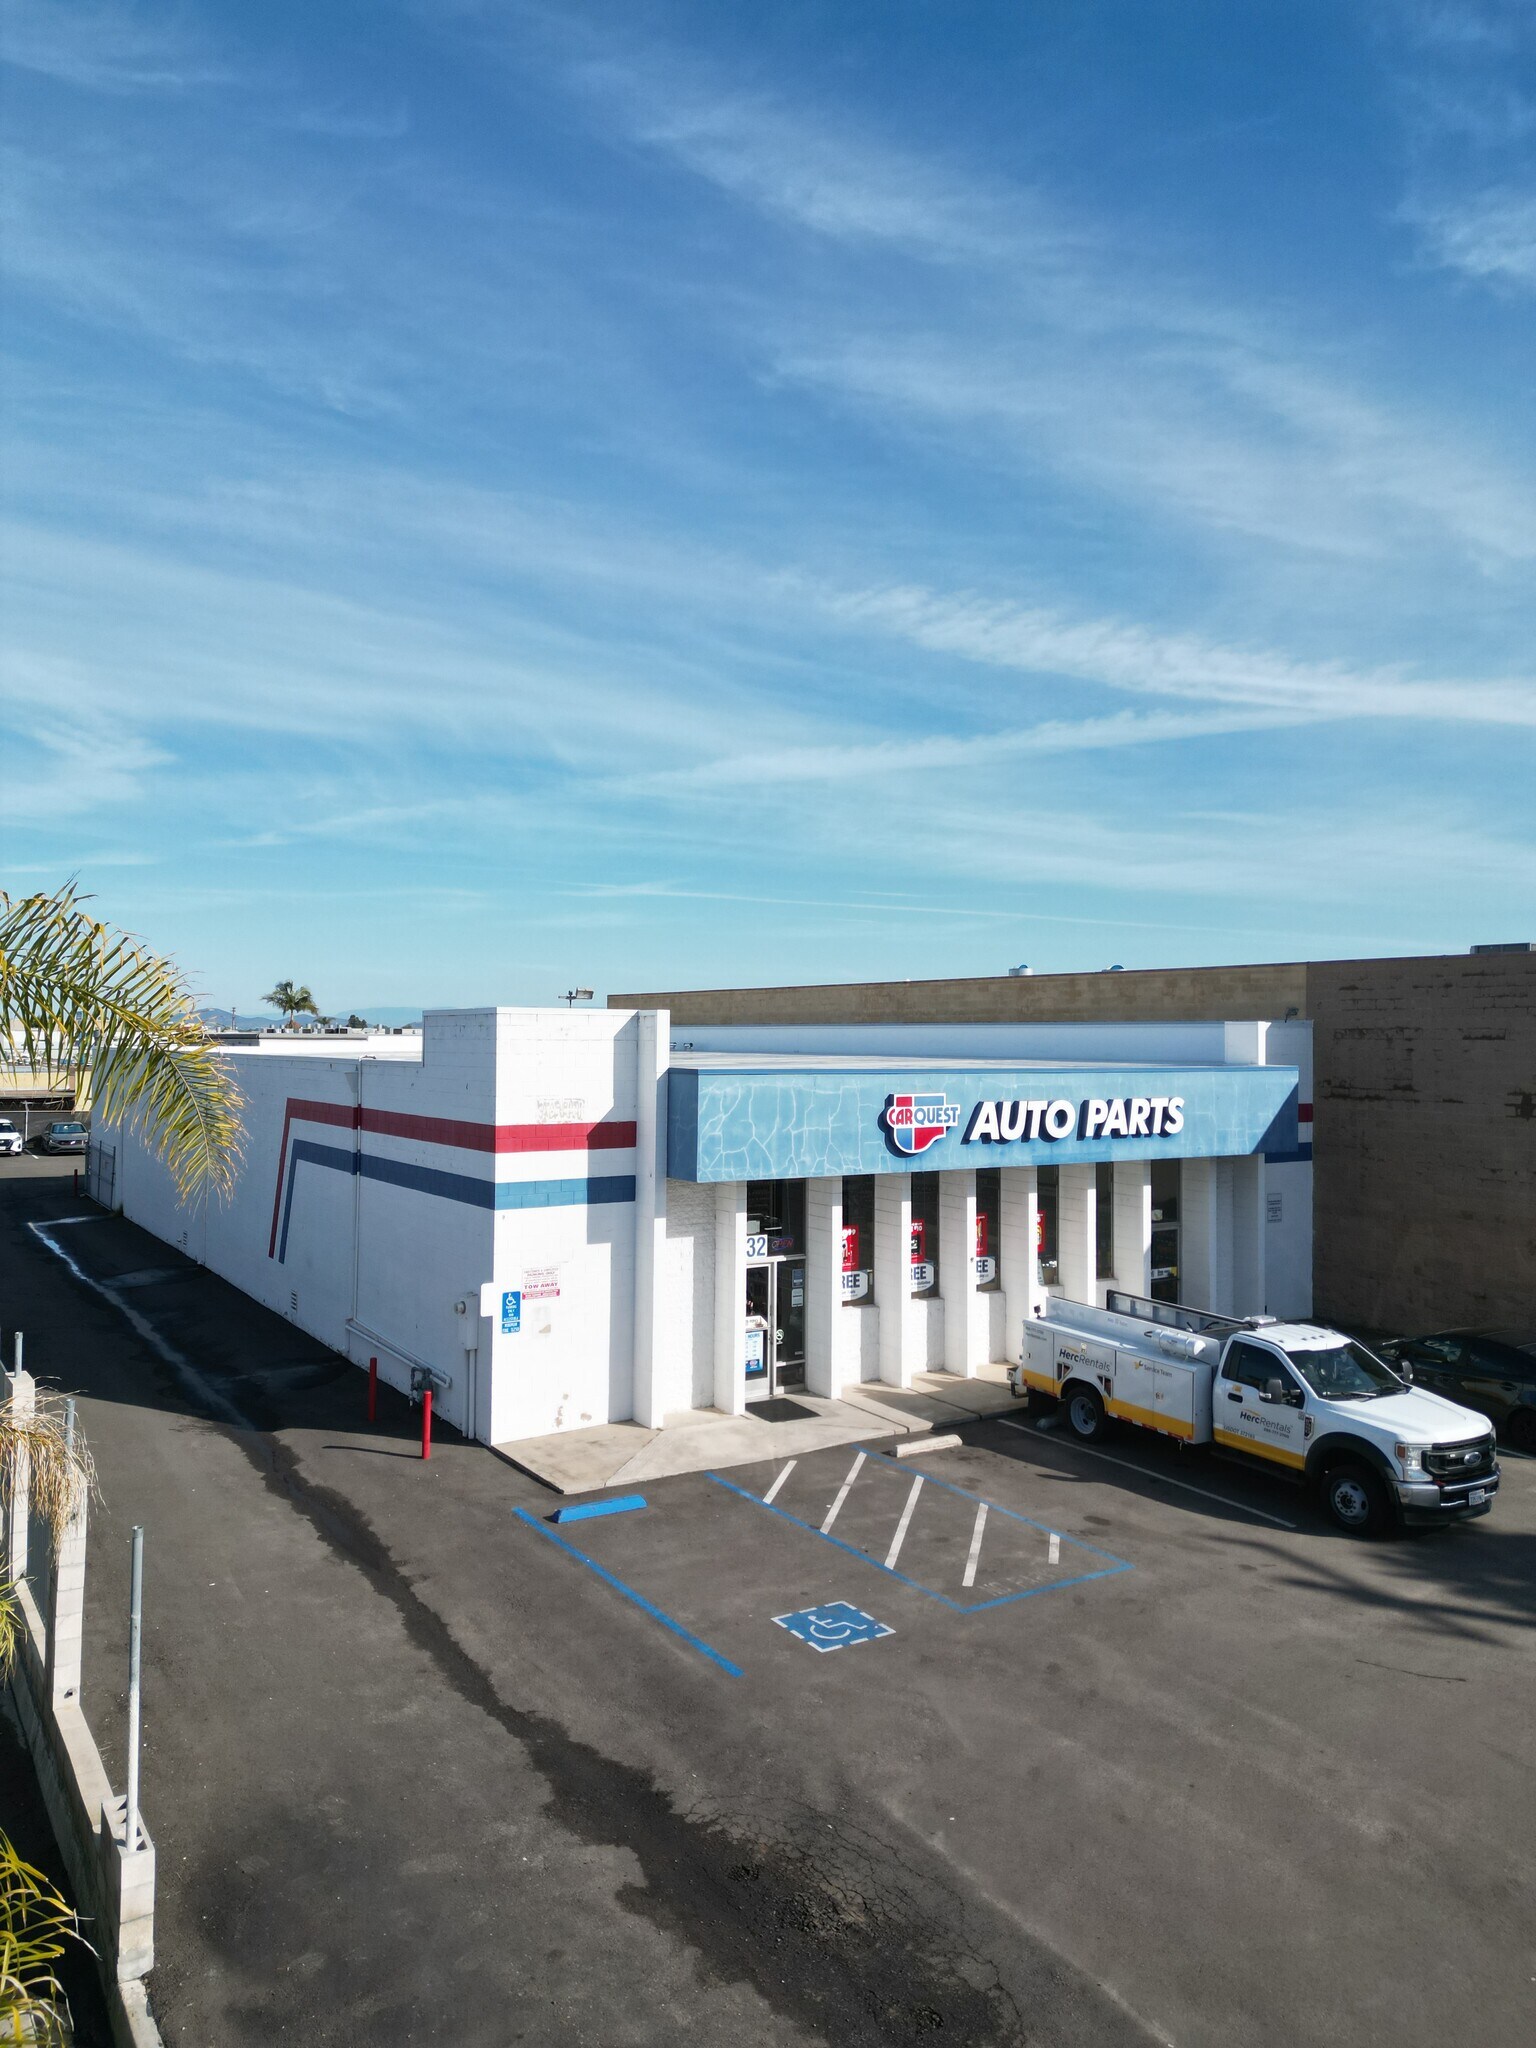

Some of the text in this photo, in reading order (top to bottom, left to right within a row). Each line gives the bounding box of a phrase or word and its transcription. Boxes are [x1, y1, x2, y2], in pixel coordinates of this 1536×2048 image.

[888, 1105, 959, 1125] CARQUEST
[969, 1097, 1185, 1142] AUTO PARTS
[746, 1236, 766, 1258] 32
[771, 1238, 794, 1250] OPEN
[911, 1265, 927, 1281] EE
[976, 1259, 989, 1273] EE
[841, 1273, 861, 1289] REE
[1059, 1347, 1112, 1372] HercRentals
[1160, 1369, 1173, 1378] Team
[1240, 1410, 1292, 1434] HercRentals
